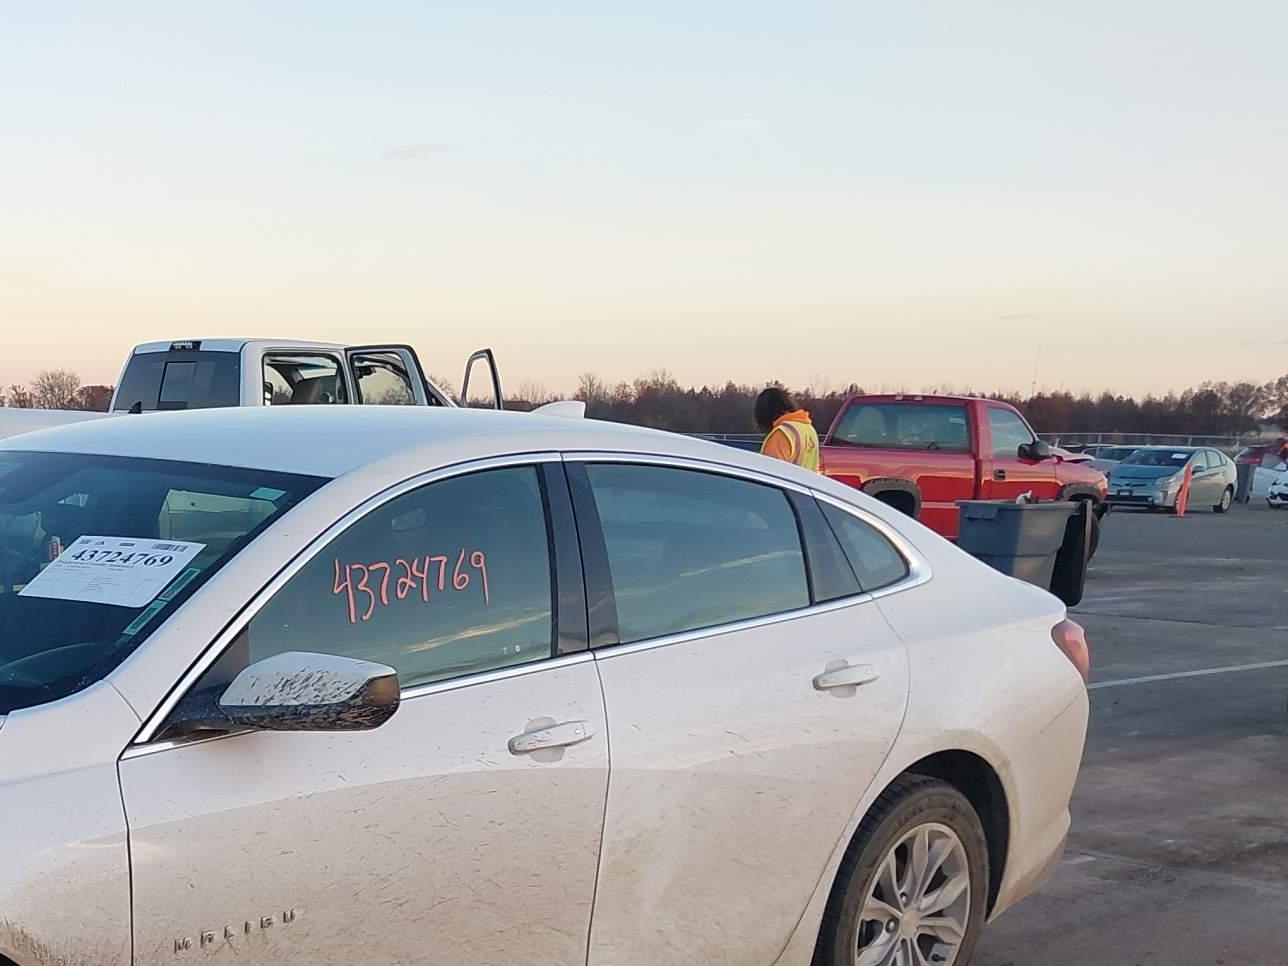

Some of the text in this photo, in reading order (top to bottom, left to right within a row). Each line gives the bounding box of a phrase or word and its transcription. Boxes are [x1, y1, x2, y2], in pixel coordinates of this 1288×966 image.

[71, 548, 174, 568] 43724769
[331, 547, 490, 624] 43724769
[174, 909, 297, 954] MALIBU
